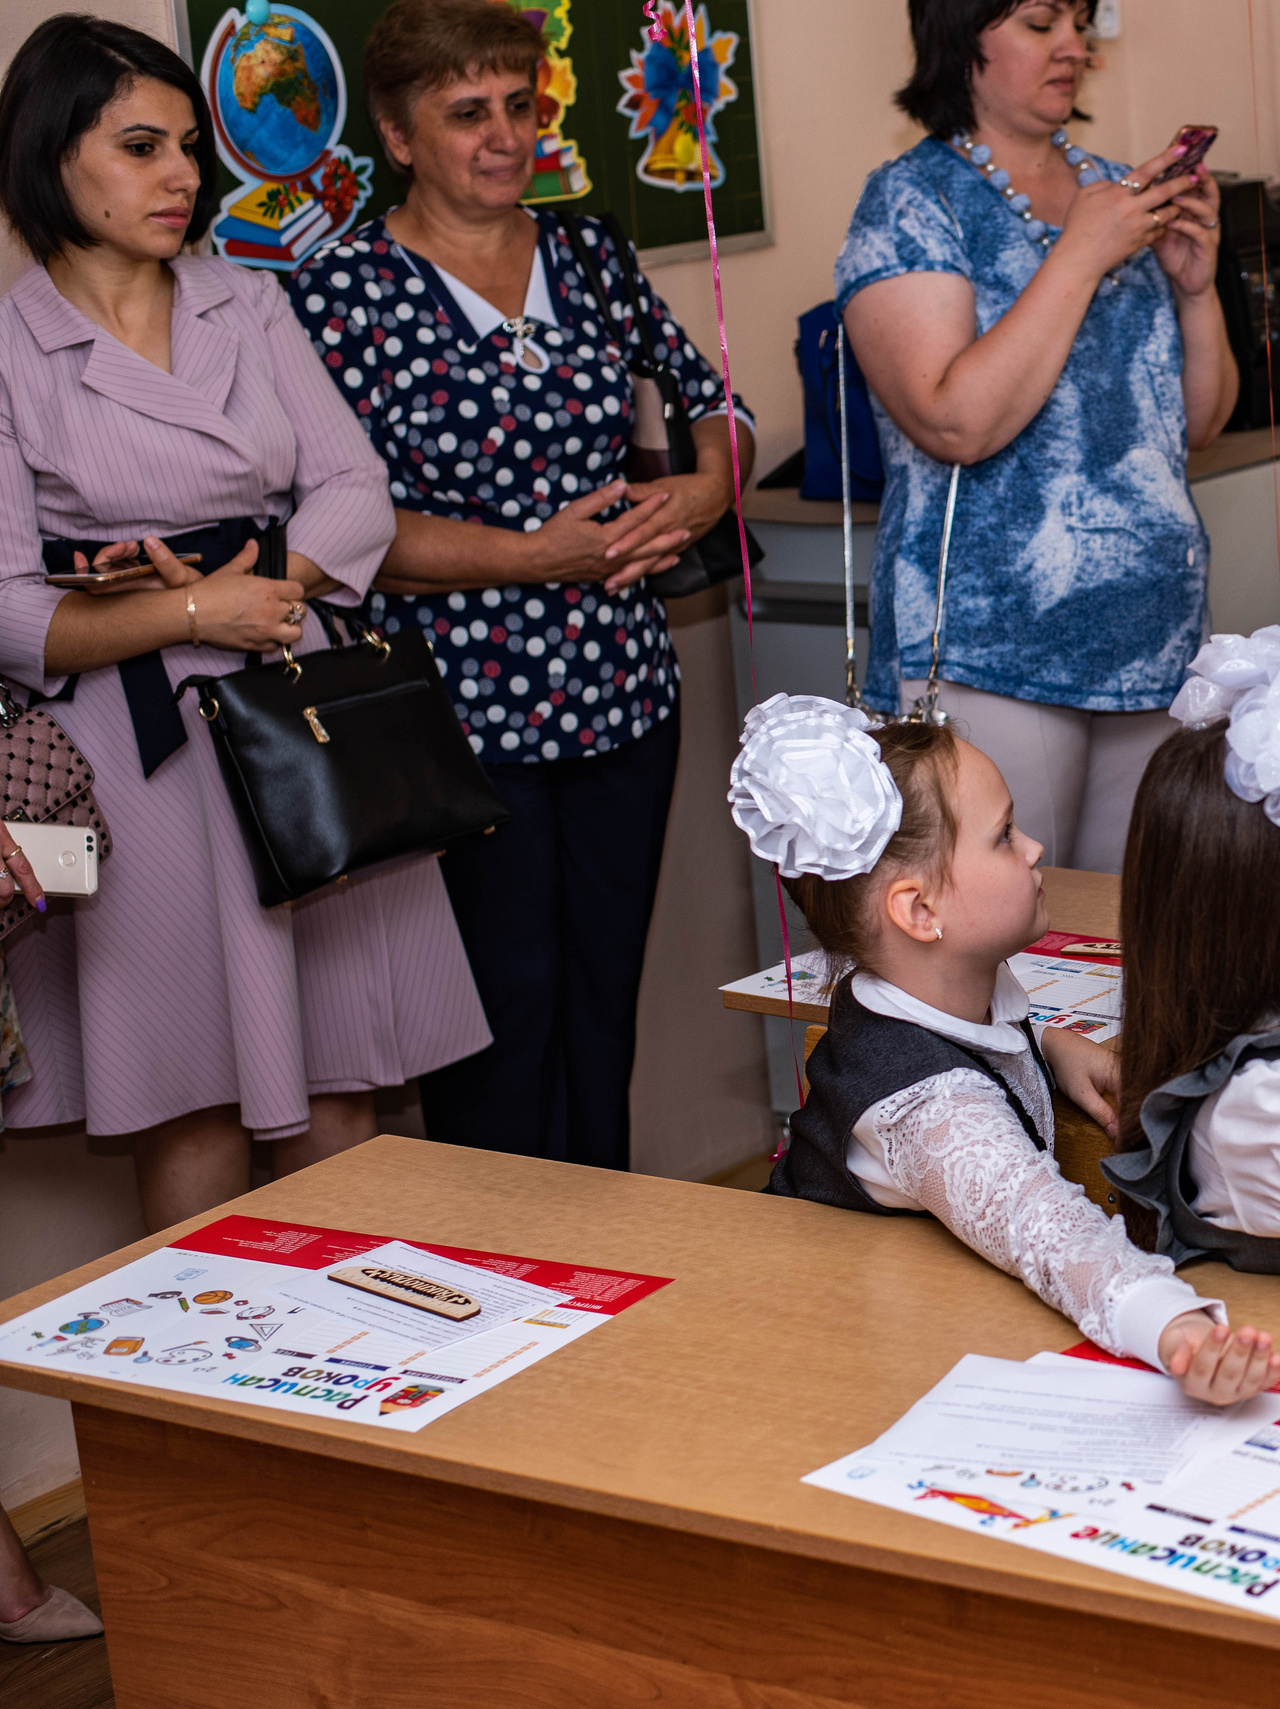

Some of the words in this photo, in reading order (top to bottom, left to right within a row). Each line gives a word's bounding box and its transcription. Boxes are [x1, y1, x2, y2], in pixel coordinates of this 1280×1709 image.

[1028, 1012, 1073, 1024] уро
[221, 1373, 369, 1410] Расписан
[280, 1366, 402, 1393] уроков
[1070, 1526, 1280, 1598] Расписание
